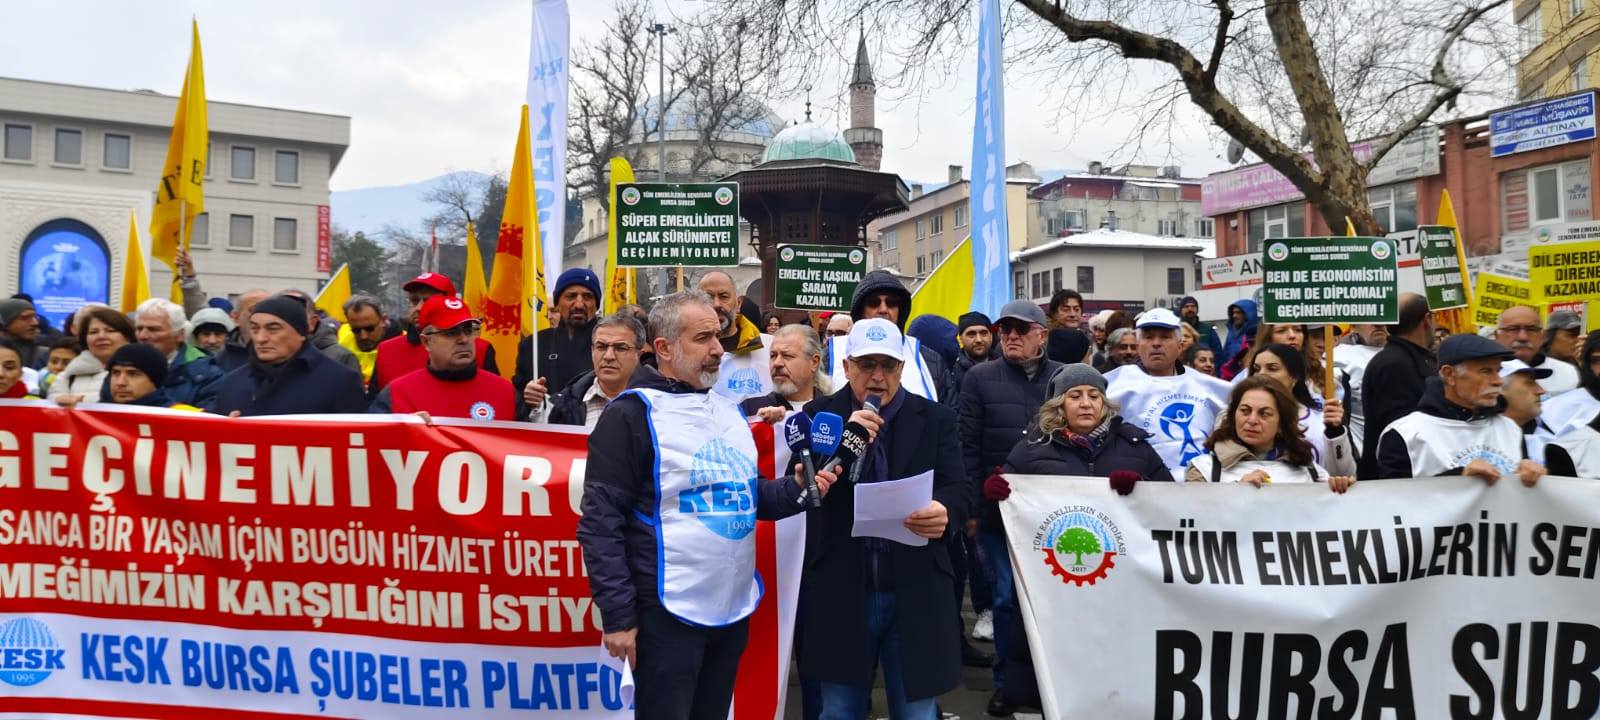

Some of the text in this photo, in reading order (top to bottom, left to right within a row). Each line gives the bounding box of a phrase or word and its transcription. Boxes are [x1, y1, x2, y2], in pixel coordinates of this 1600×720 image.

[622, 213, 734, 227] SÜPER EMEKLİLİKTEN
[625, 229, 731, 245] ALÇAK SÜRÜNMEYE!
[778, 267, 860, 283] EMEKLİYE KAŞIKLA
[1266, 271, 1290, 283] BEN
[1293, 270, 1308, 283] DE
[1312, 267, 1394, 282] EKONOMİSTİM
[802, 282, 837, 294] SARAYA
[1304, 287, 1320, 299] DE
[796, 294, 837, 307] KAZANLA
[1277, 303, 1377, 318] GEÇİNEMİYORUM
[727, 379, 763, 393] KESK
[0, 505, 589, 578] SANCA BİR YAŞAM İÇİN BUGÜN HİZMET ÜRET
[1151, 518, 1244, 585] TÜM
[1253, 510, 1518, 586] EMEKLİLERİN
[0, 556, 205, 610] MEĞİMİZİN
[218, 576, 464, 629] KARŞILIĞINI
[0, 648, 66, 669] ESK
[81, 633, 635, 713] KESK BURSA ŞUBELER PLATFO
[1154, 622, 1416, 720] BURSA
